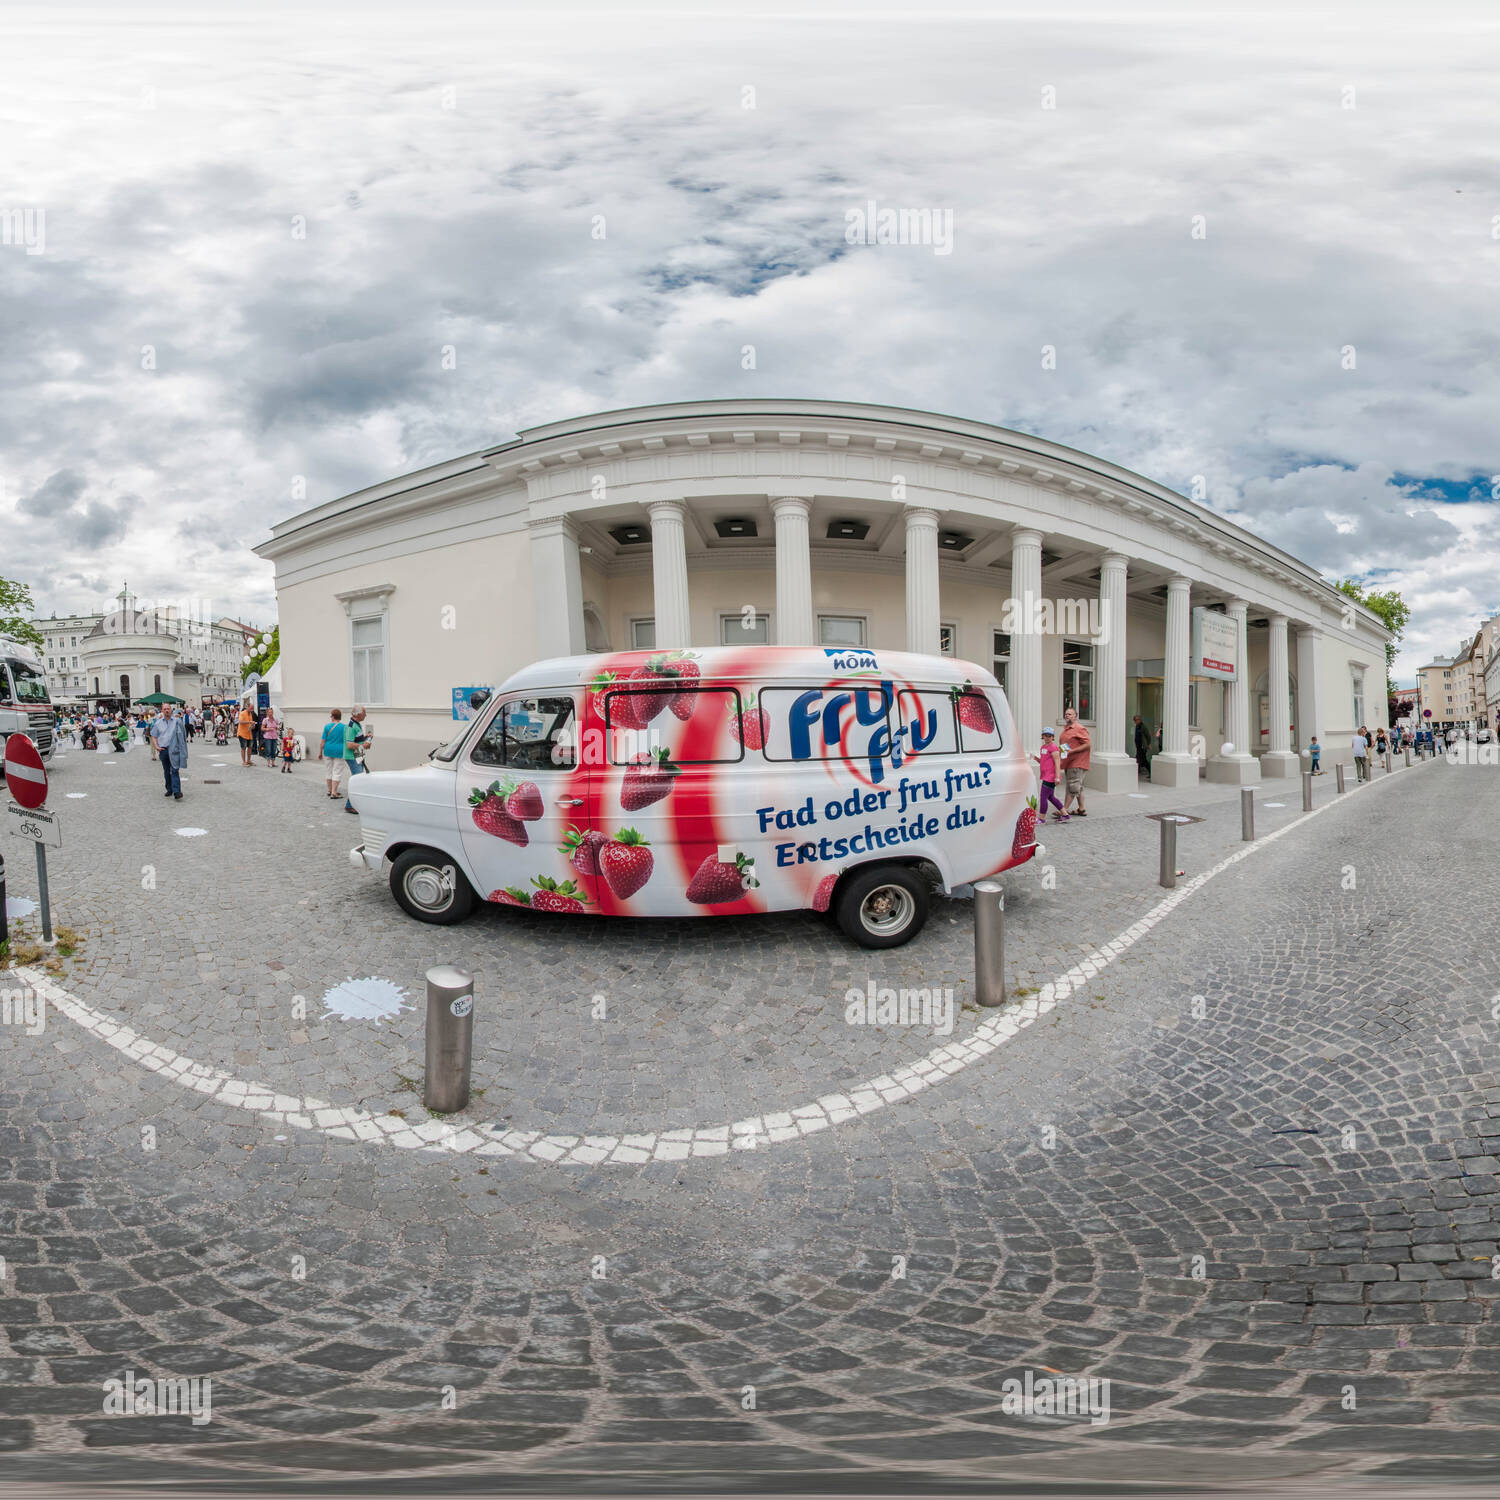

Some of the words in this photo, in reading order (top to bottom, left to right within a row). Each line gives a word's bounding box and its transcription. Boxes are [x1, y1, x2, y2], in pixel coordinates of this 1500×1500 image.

[8, 806, 53, 823] ausgenommen
[755, 797, 817, 834] Fad
[824, 788, 892, 821] oder
[898, 778, 940, 813] fru
[945, 762, 993, 802] fru?
[775, 812, 940, 868] Entscheide
[946, 806, 986, 831] du.
